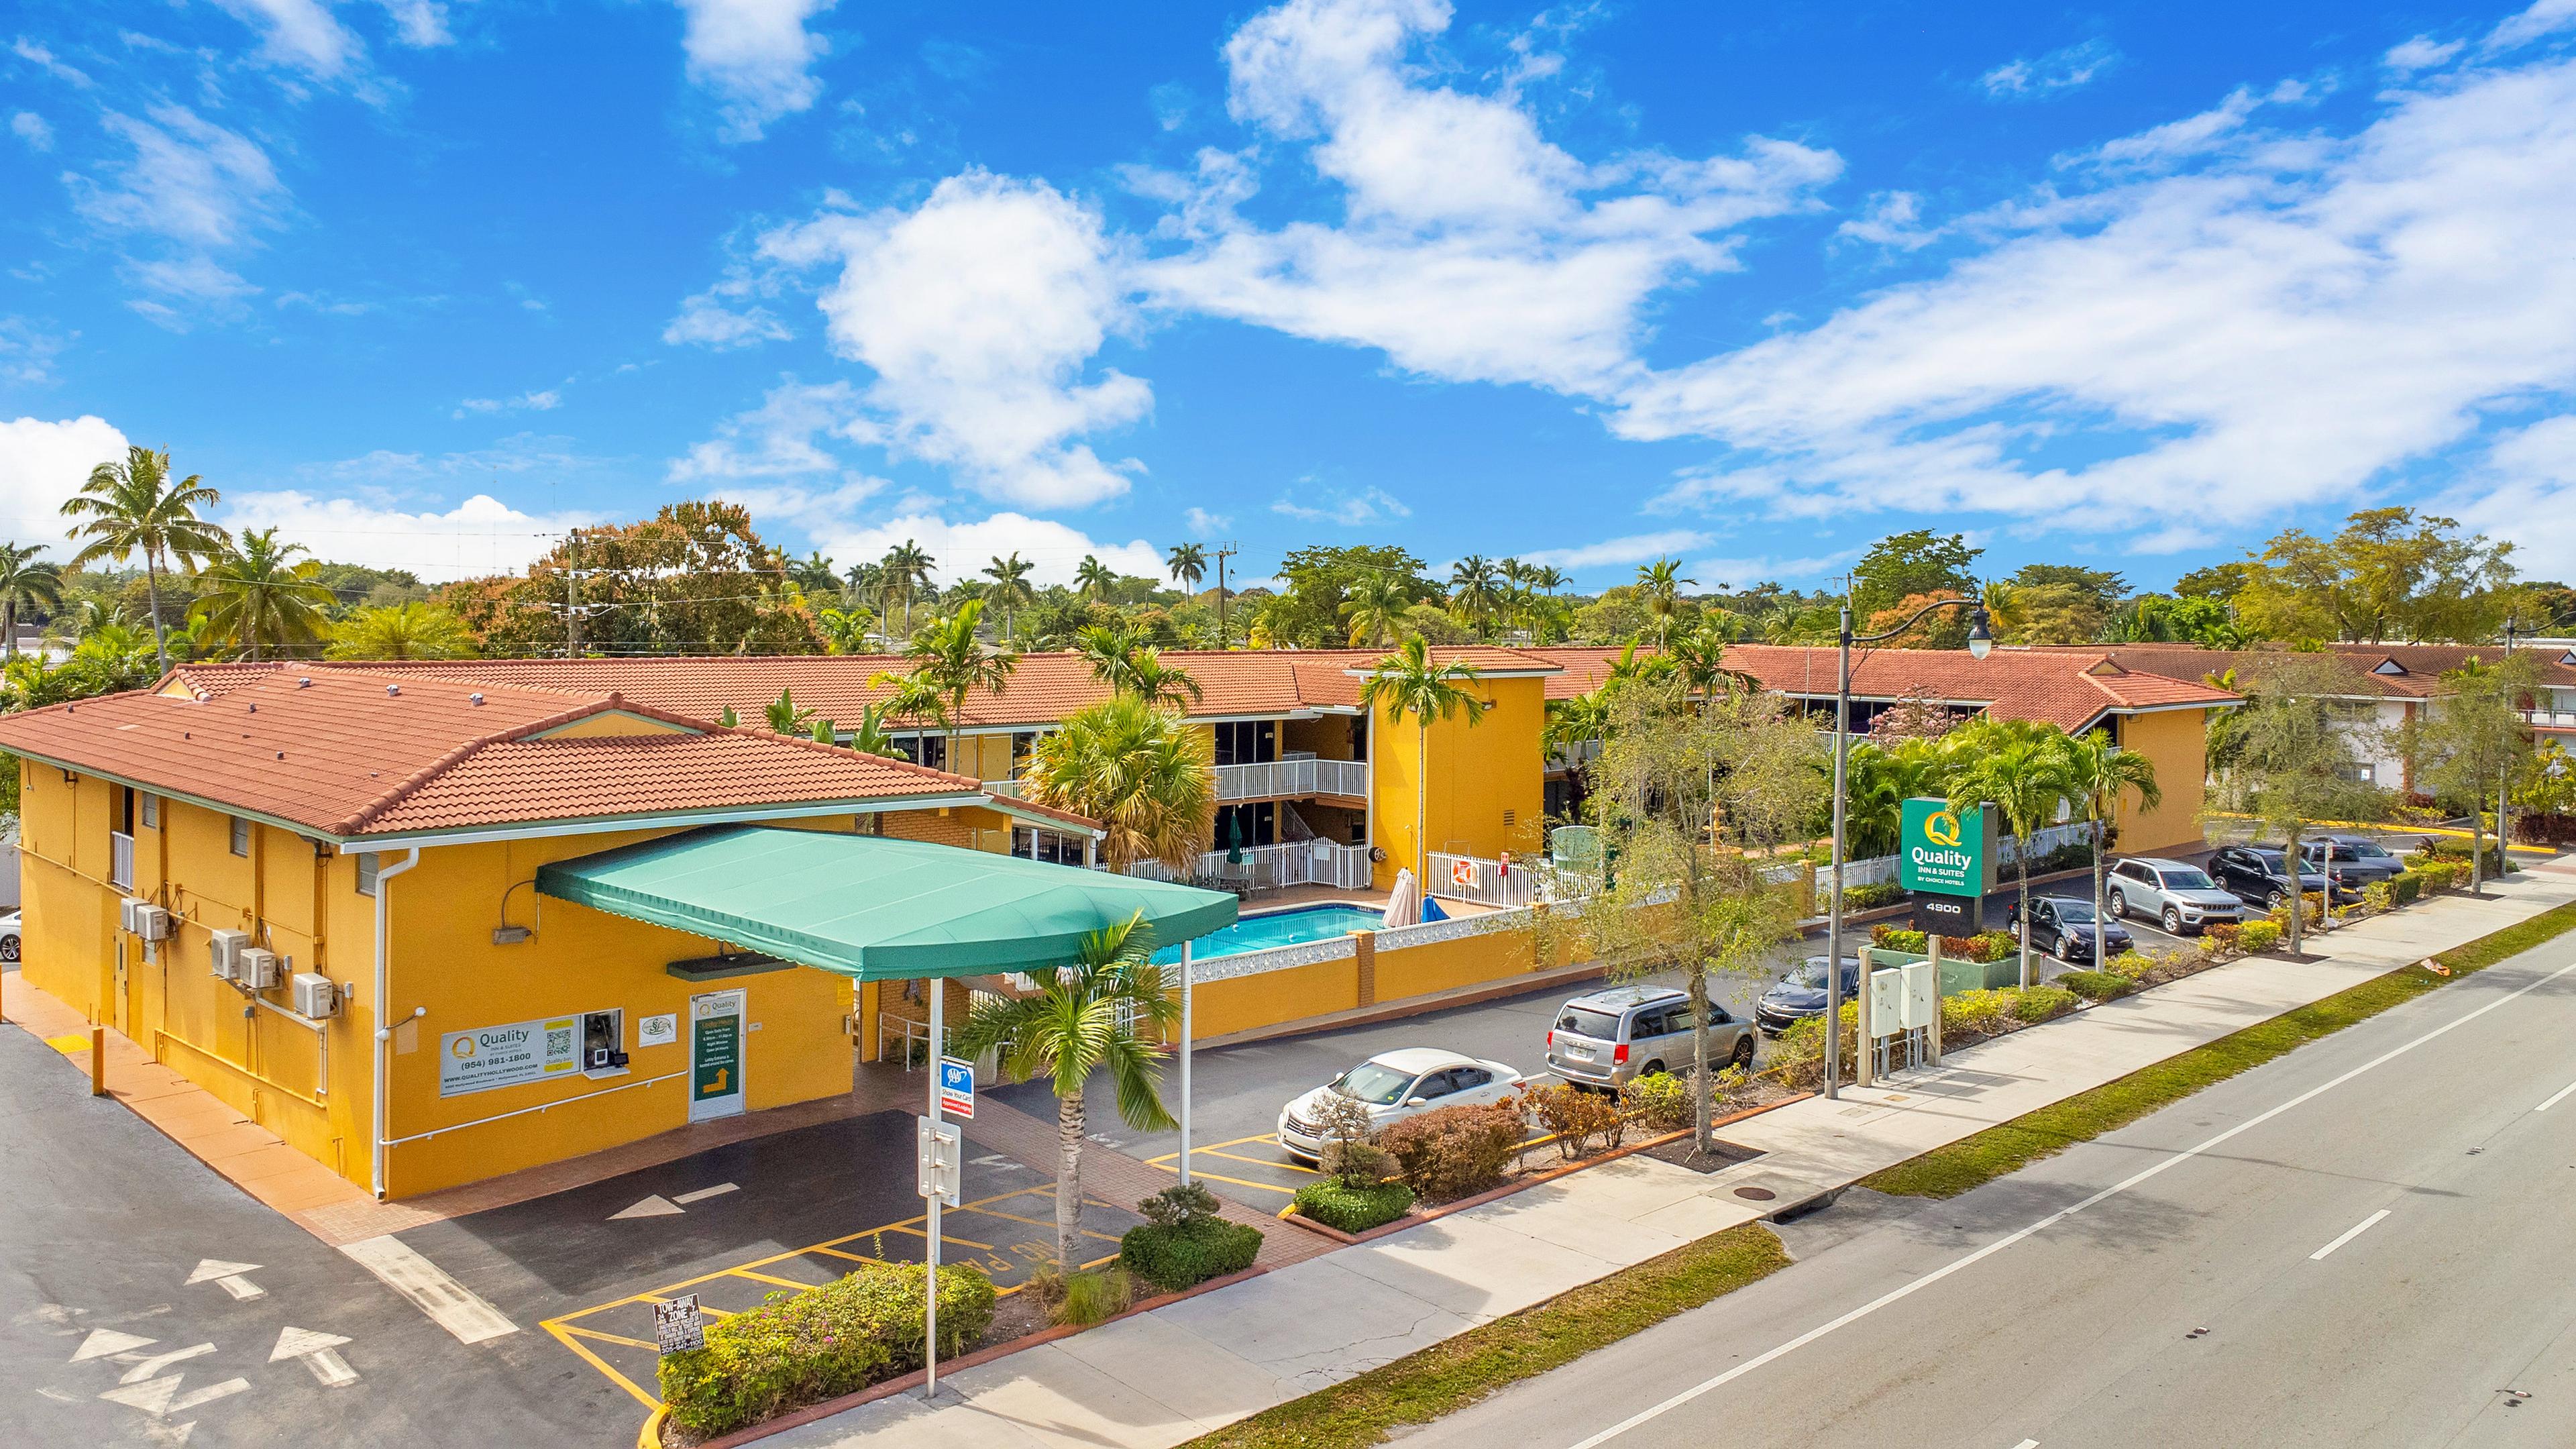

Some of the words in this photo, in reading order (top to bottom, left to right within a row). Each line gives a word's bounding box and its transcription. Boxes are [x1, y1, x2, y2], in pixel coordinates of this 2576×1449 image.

[1911, 847, 1972, 871] Quality
[1918, 866, 1931, 874] INN
[1938, 868, 1965, 877] SUITES
[1926, 903, 1961, 914] 4900
[712, 1000, 736, 1010] Quality
[480, 1030, 530, 1047] Quality
[461, 1059, 486, 1071] (954)
[488, 1053, 531, 1065] 981-1800
[444, 1063, 538, 1083] WWW.QUALITYHOLLYWOOD.COM
[657, 1295, 694, 1314] TOW-AWAY
[668, 1308, 688, 1322] ZONE
